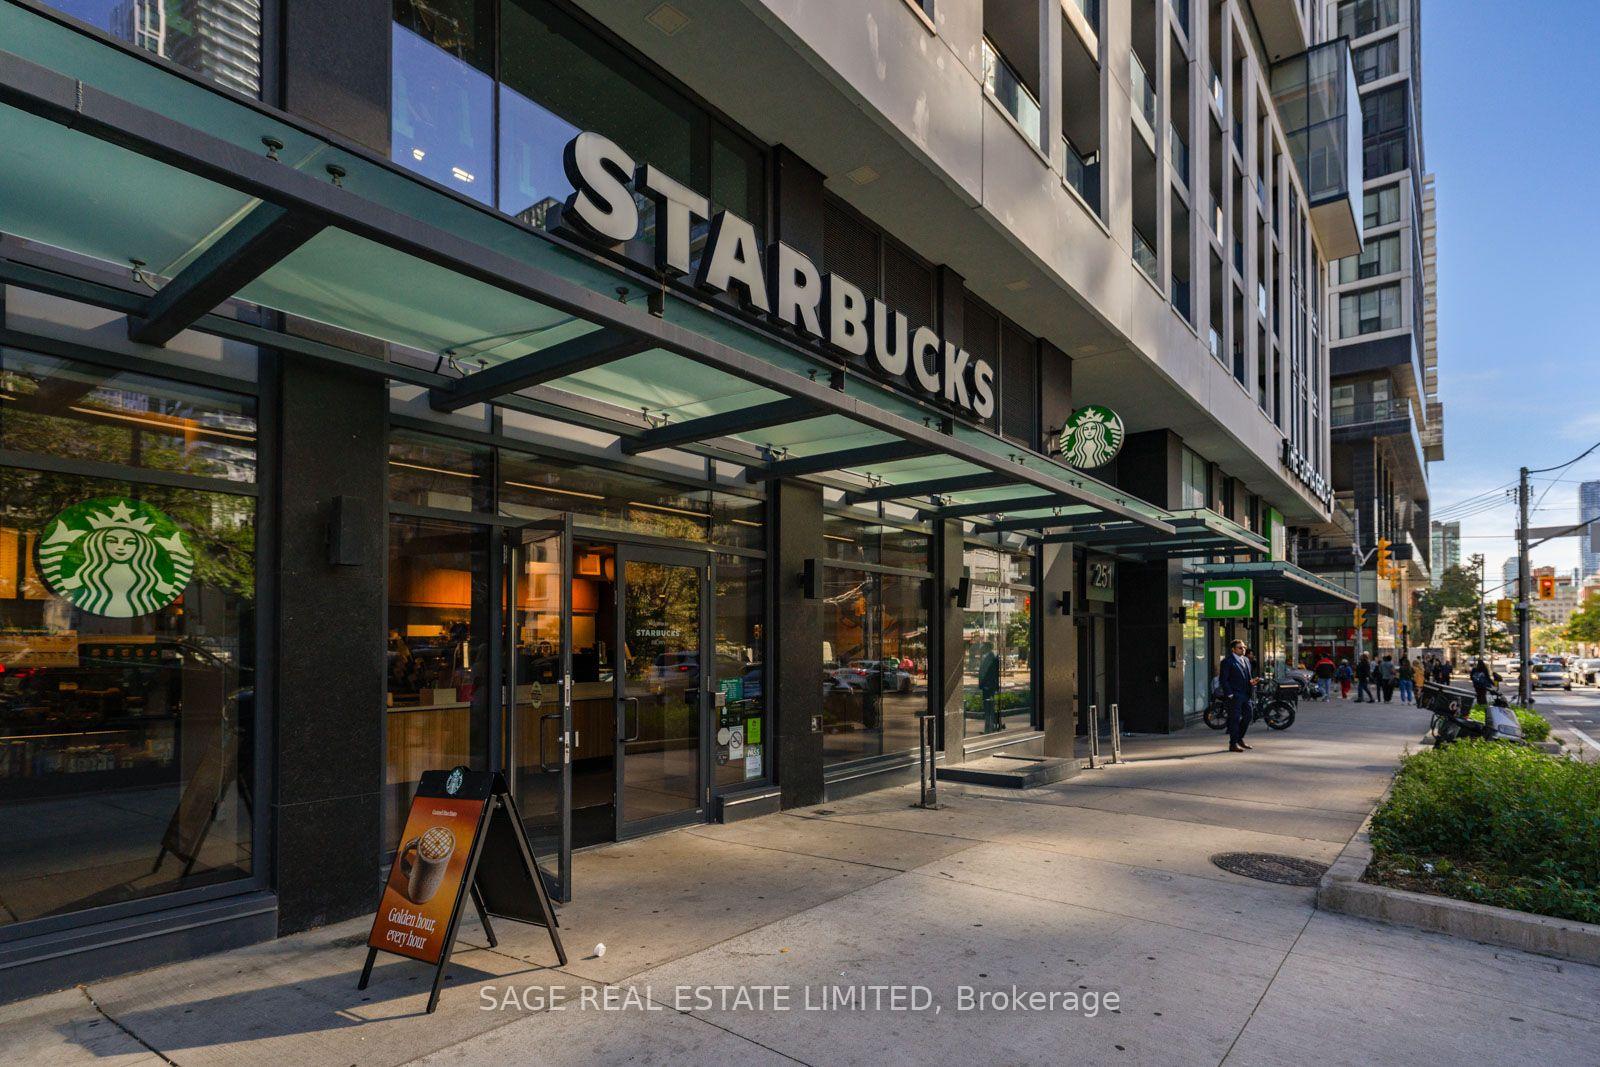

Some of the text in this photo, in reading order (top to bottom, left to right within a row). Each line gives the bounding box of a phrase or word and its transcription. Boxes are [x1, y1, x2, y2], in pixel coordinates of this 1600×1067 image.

[565, 131, 996, 421] STARBUCKS
[1096, 563, 1112, 589] 251
[1208, 586, 1246, 611] TD
[635, 629, 680, 637] STARBUCKS
[388, 907, 437, 934] Golden hour,
[386, 929, 427, 950] every hour
